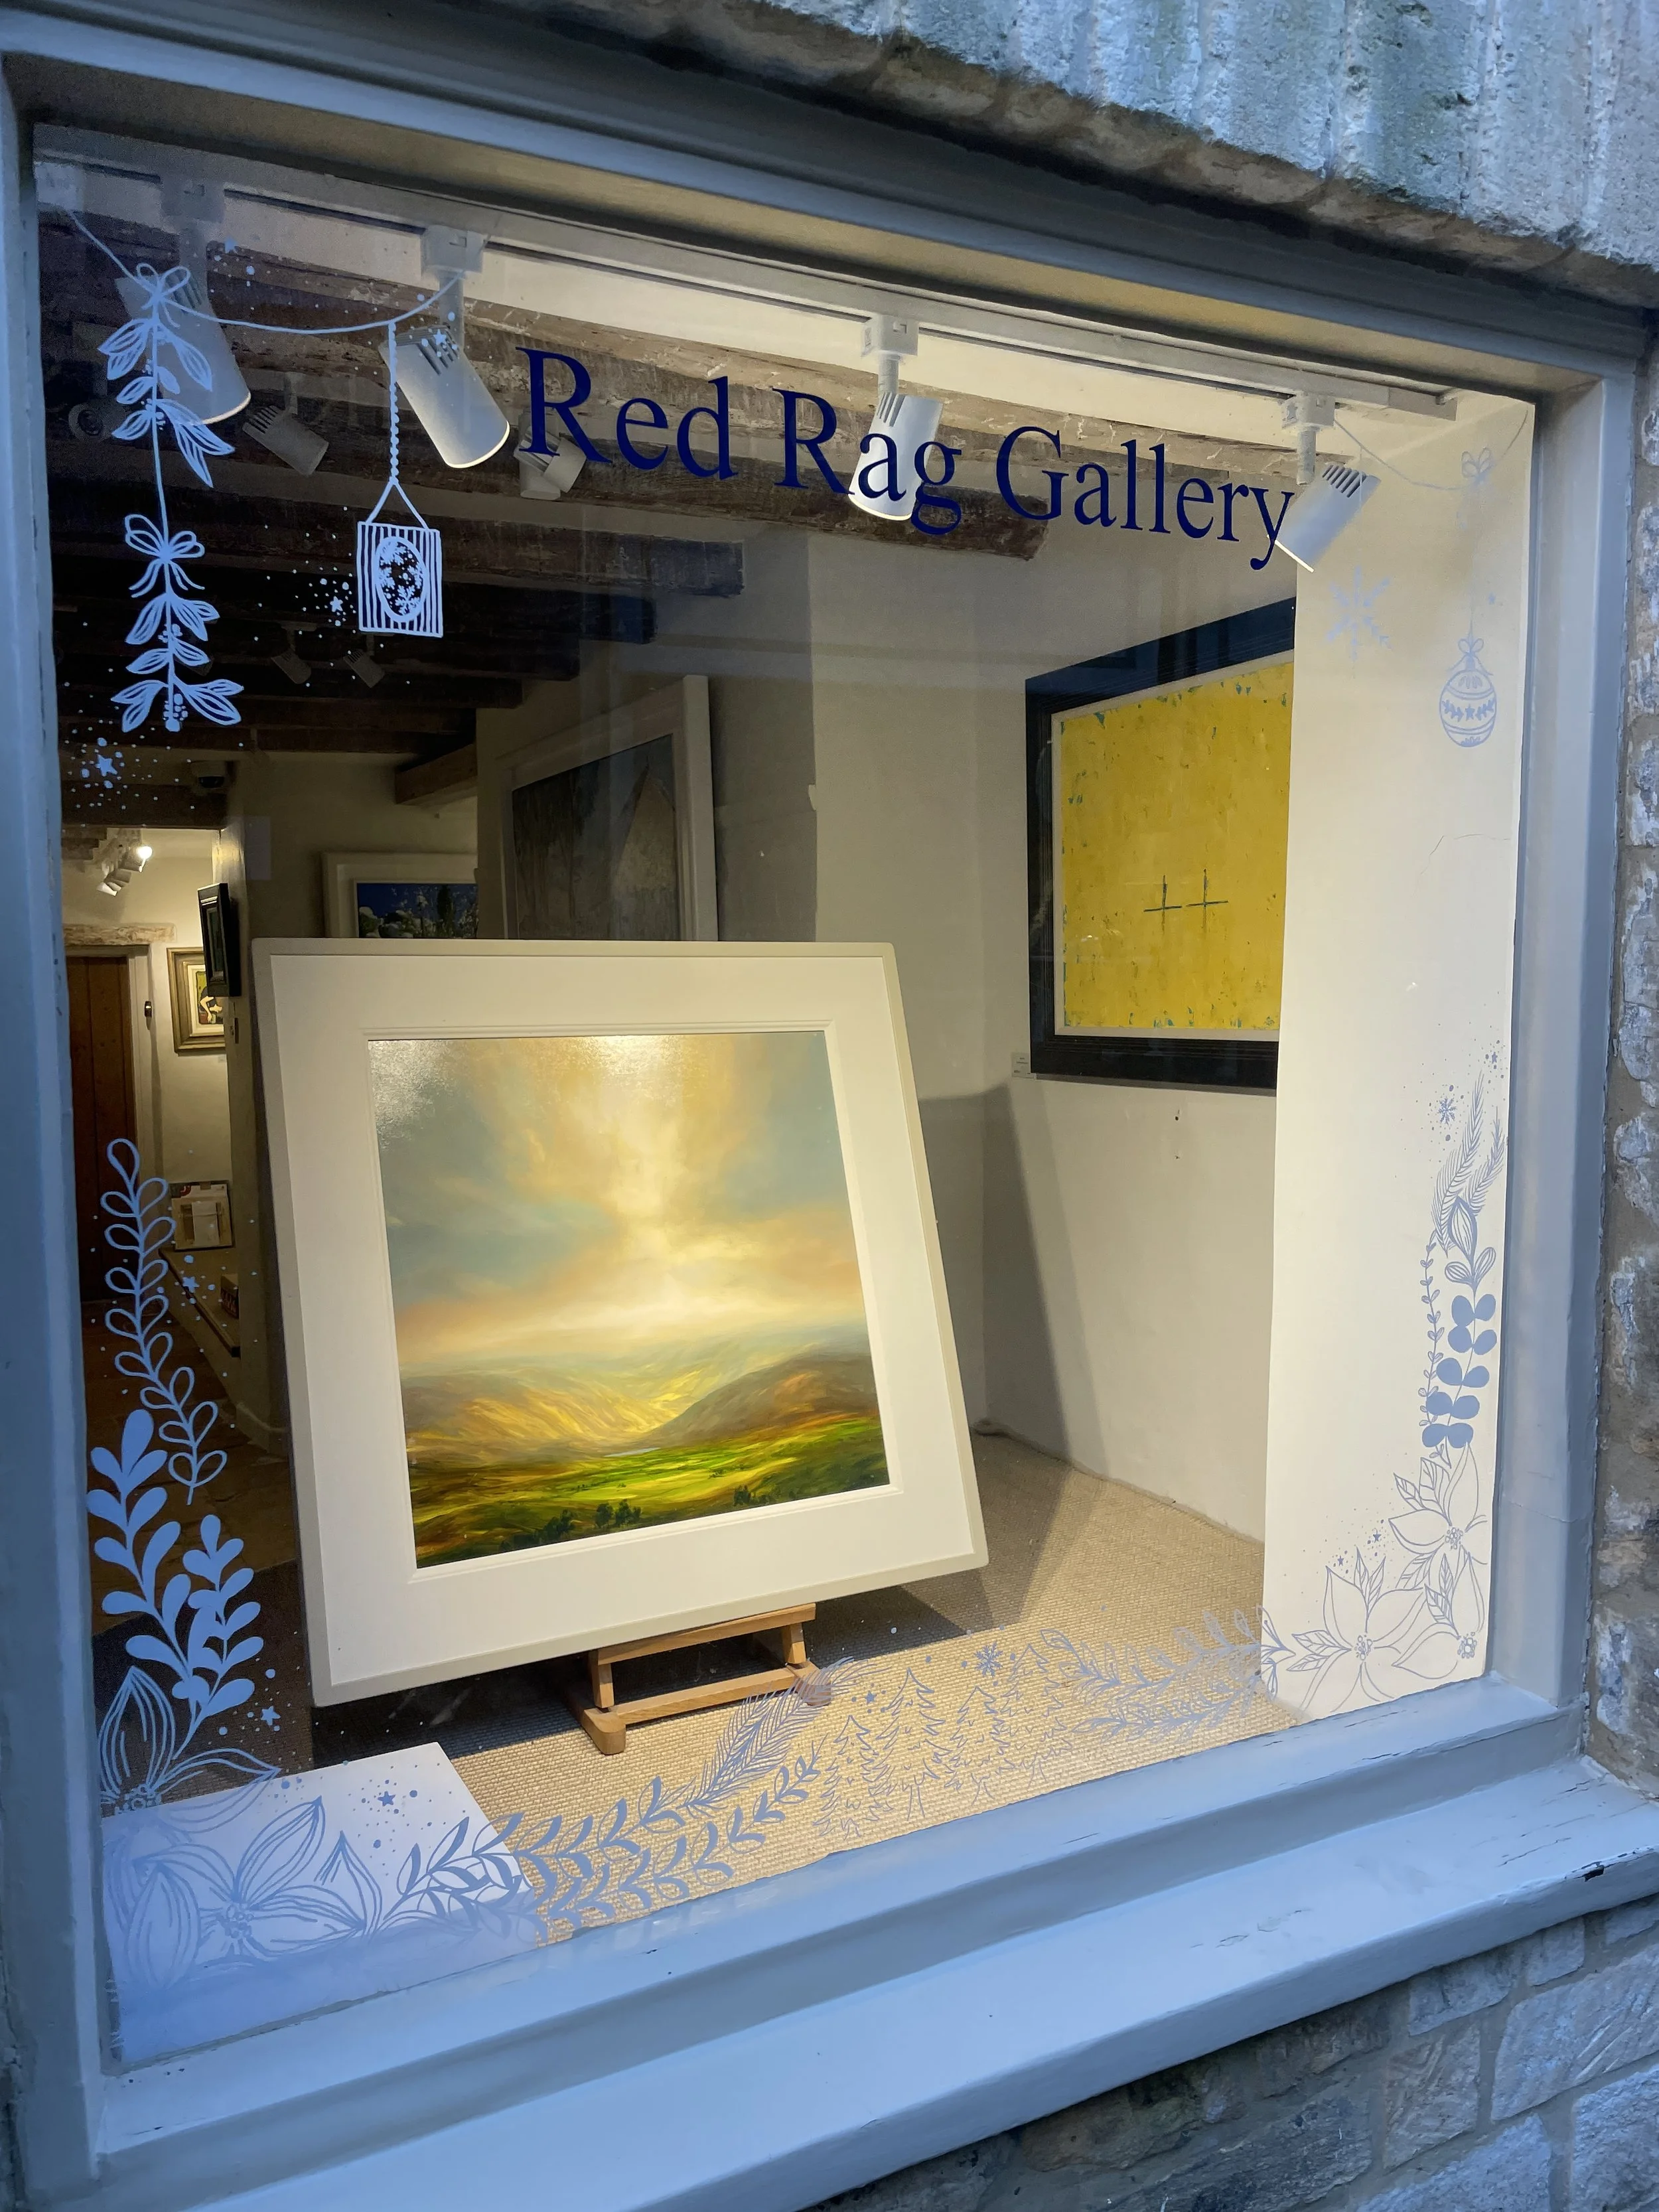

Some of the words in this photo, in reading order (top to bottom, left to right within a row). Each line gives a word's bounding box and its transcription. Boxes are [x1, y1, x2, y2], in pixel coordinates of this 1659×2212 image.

[516, 347, 738, 480] Red
[772, 388, 962, 535] Rag
[996, 426, 1295, 570] Gallery
